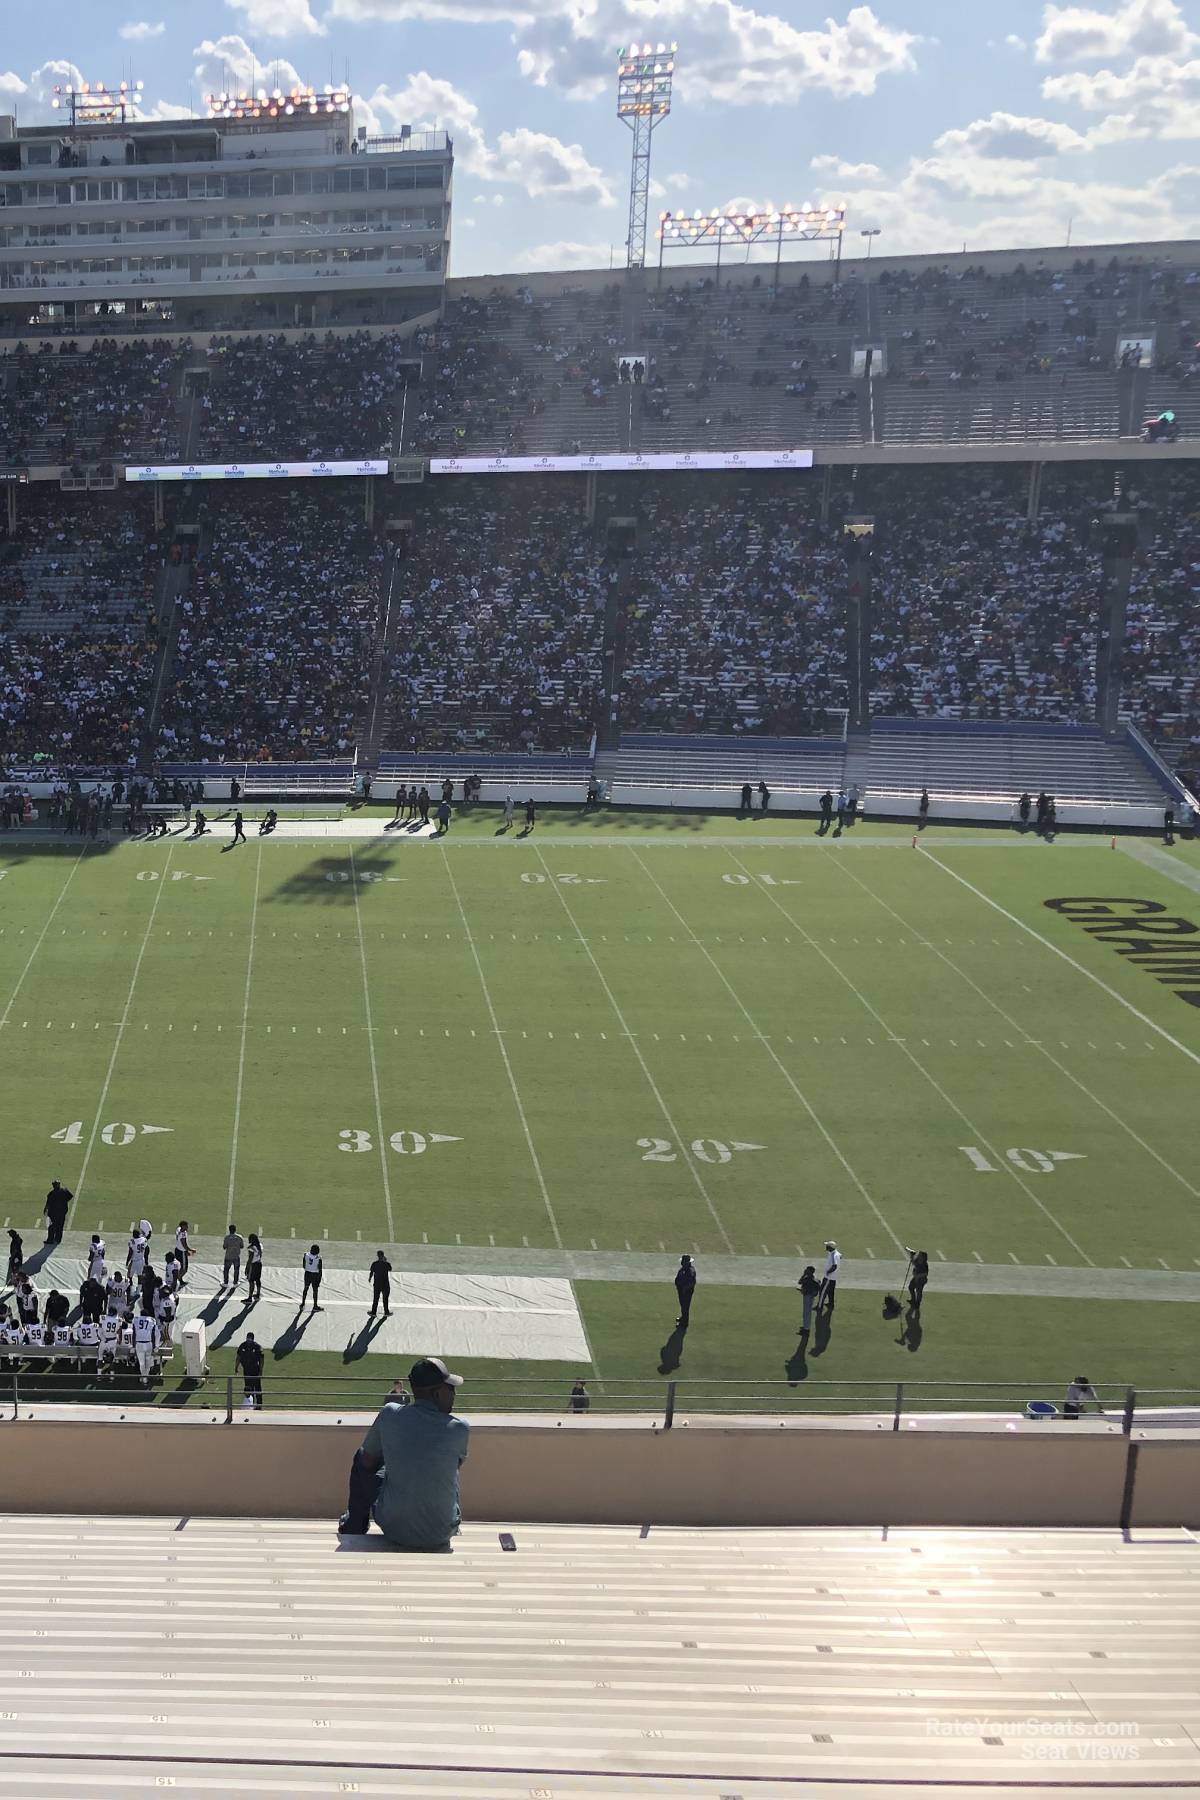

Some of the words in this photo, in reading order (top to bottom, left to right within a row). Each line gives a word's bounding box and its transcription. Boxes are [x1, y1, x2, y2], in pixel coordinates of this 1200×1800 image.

[136, 871, 193, 882] 40
[520, 873, 582, 884] 20
[722, 874, 777, 885] 10
[50, 1121, 137, 1146] 40
[337, 1129, 428, 1154] 30
[636, 1138, 732, 1164] 20
[958, 1147, 1055, 1172] 10
[106, 1322, 116, 1332] 99
[139, 1320, 149, 1330] 97
[32, 1330, 41, 1339] 59
[58, 1331, 67, 1340] 98
[82, 1328, 92, 1338] 92
